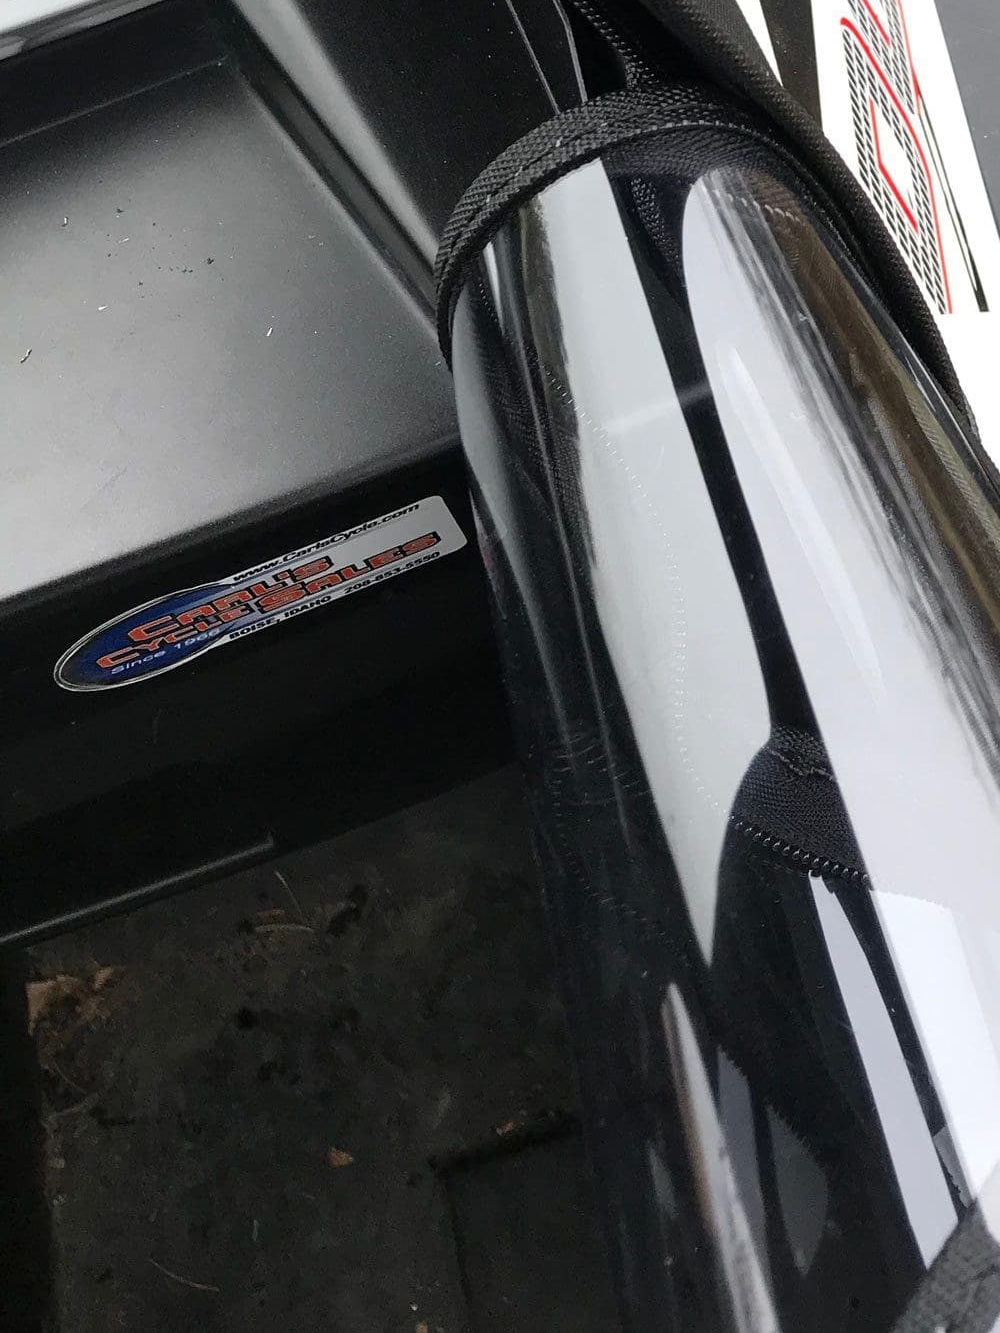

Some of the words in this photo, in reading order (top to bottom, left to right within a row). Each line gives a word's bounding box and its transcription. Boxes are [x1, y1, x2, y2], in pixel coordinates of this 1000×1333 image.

[233, 503, 420, 581] www.CarlsCycle.com
[95, 602, 256, 670] CYCLE
[255, 530, 441, 614] SALES
[126, 555, 334, 643] CARL'S
[284, 595, 332, 618] IDAHO
[111, 650, 166, 675] Since
